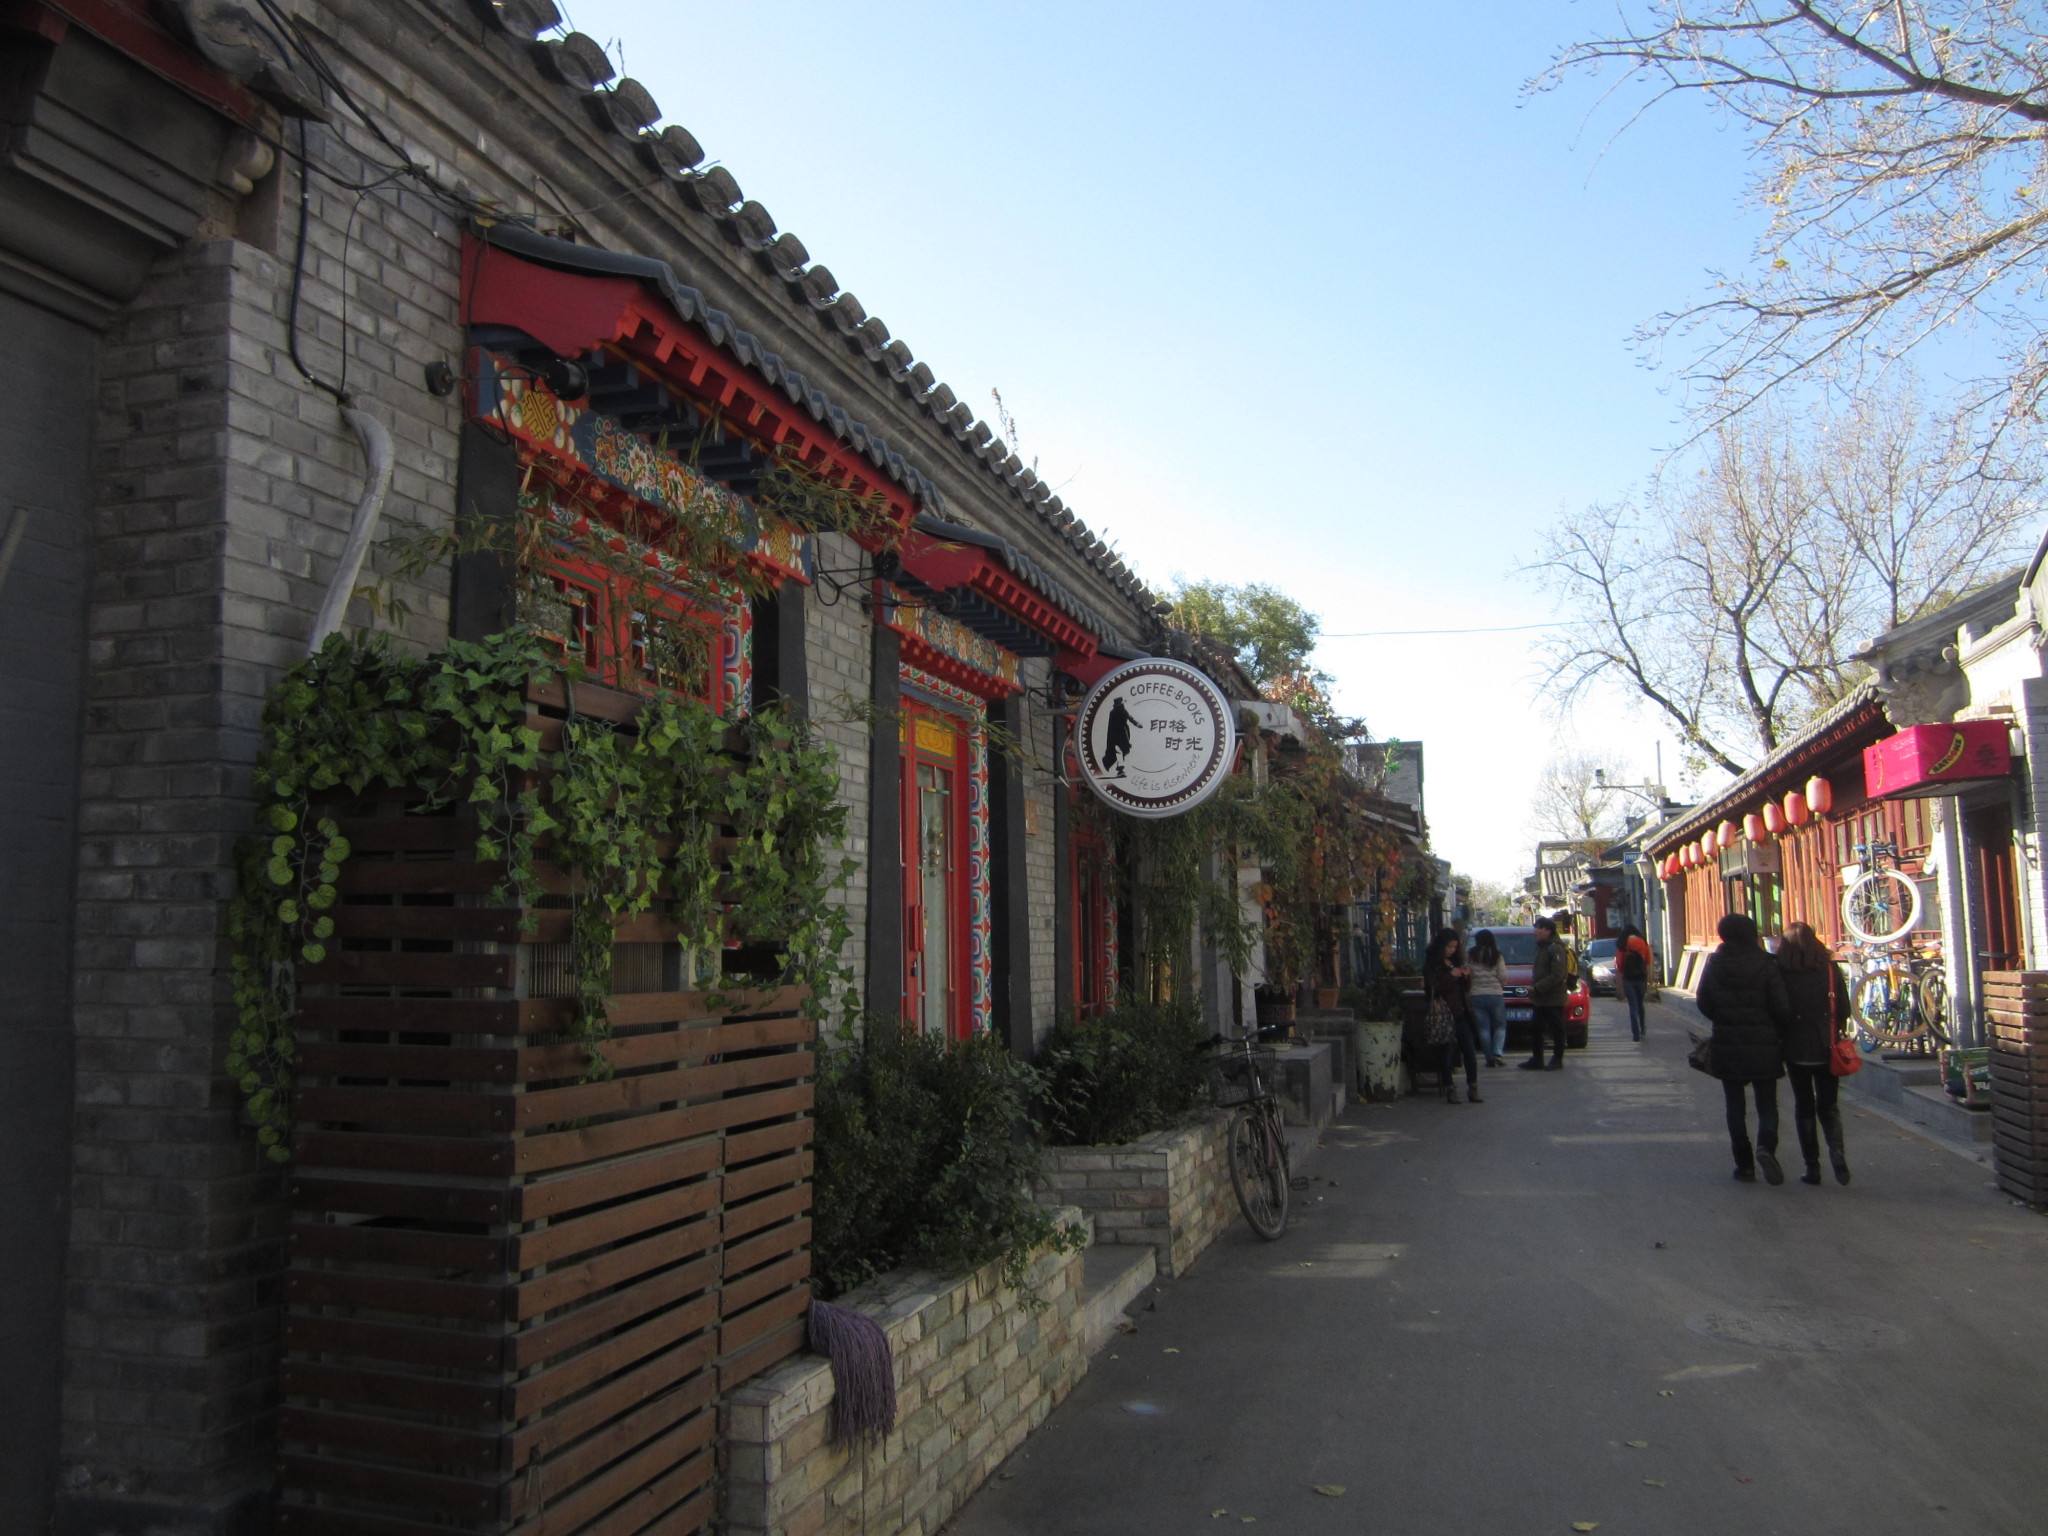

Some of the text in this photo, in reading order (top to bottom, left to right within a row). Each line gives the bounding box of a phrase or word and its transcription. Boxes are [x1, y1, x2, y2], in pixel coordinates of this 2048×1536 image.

[1150, 719, 1187, 733] 印格
[1165, 736, 1203, 751] 时光
[1151, 781, 1161, 791] is
